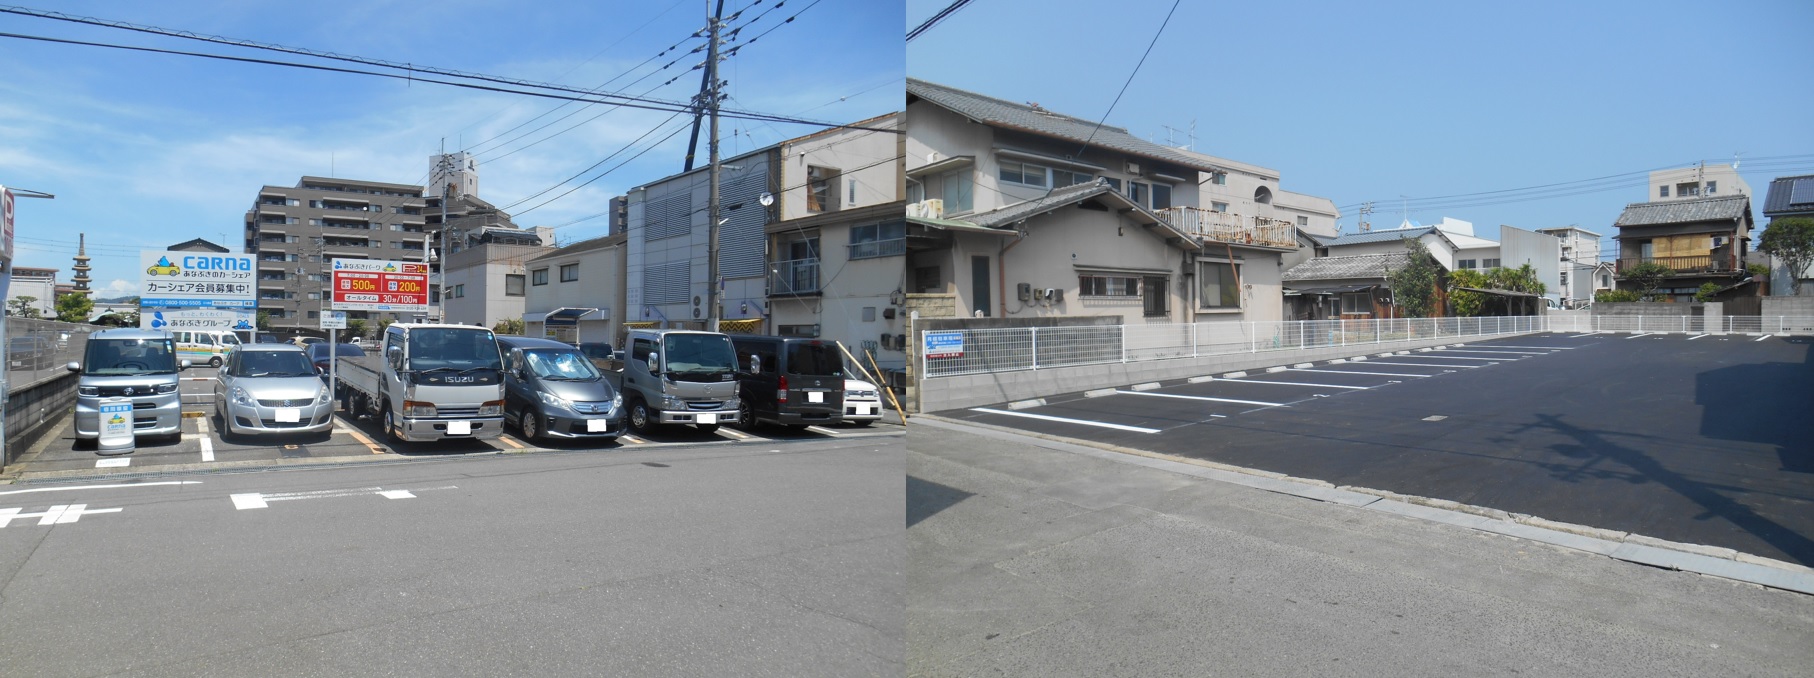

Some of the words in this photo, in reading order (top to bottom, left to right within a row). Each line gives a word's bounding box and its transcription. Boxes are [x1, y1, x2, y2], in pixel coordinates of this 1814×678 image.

[183, 271, 251, 279] あなぶきのカーシェア
[148, 283, 250, 294] カーシェア会員募集中!
[352, 280, 375, 290] 500円
[399, 282, 421, 291] 200円
[383, 295, 418, 304] 30分/100円
[170, 319, 232, 327] あなぶきグループ
